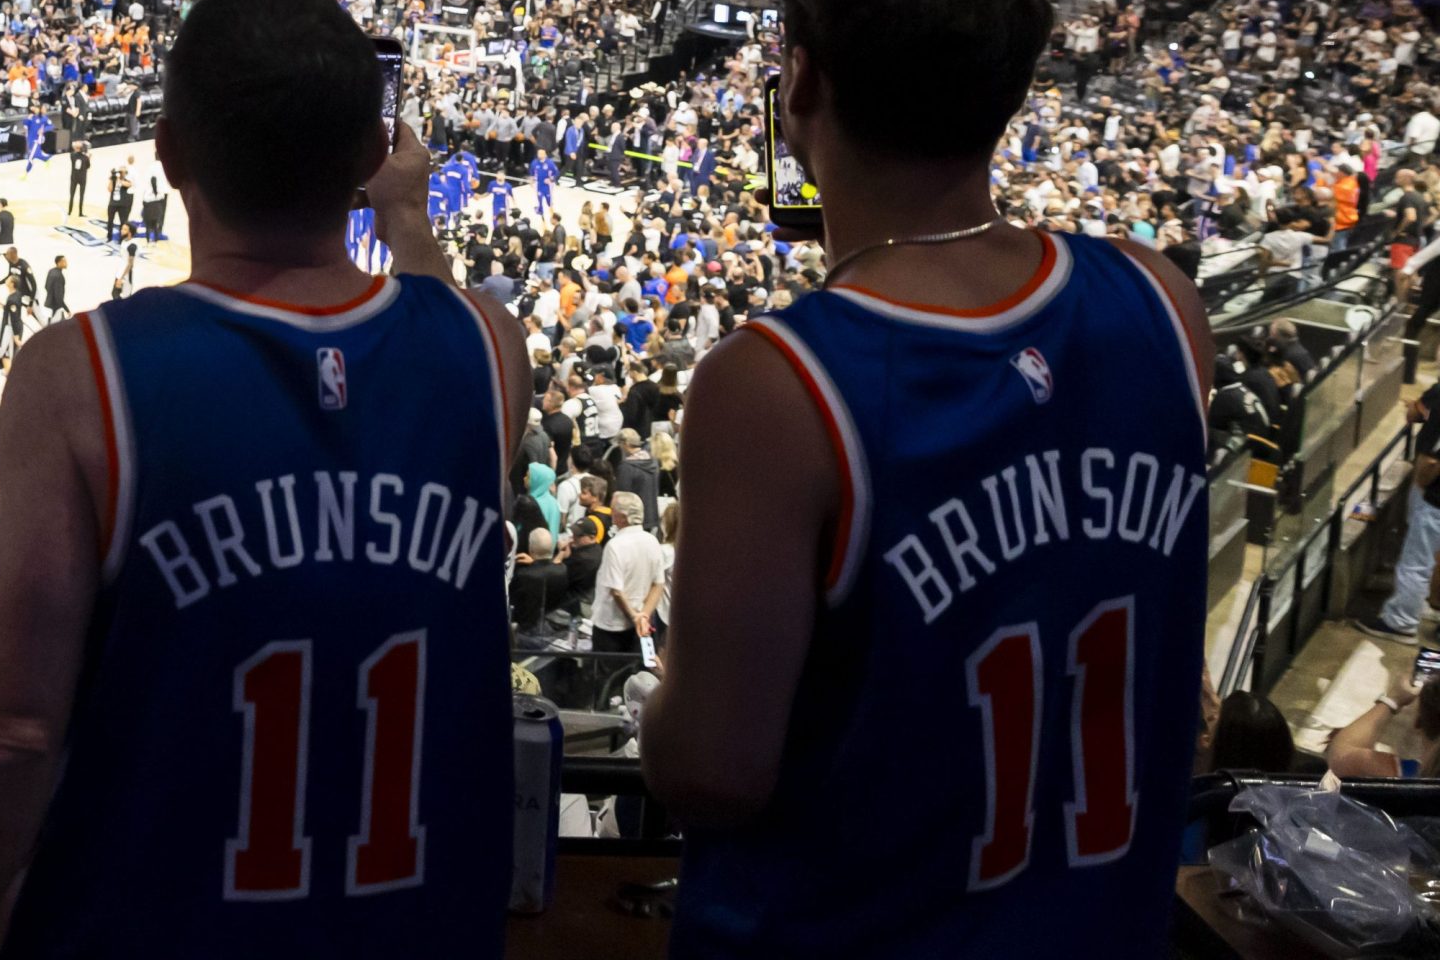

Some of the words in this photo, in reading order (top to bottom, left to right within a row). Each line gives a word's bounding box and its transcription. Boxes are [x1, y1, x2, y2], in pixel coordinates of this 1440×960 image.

[140, 471, 500, 610] BRUNSON
[882, 447, 1207, 625] BRUNSON
[223, 628, 428, 901] 11
[964, 594, 1141, 893] 11
